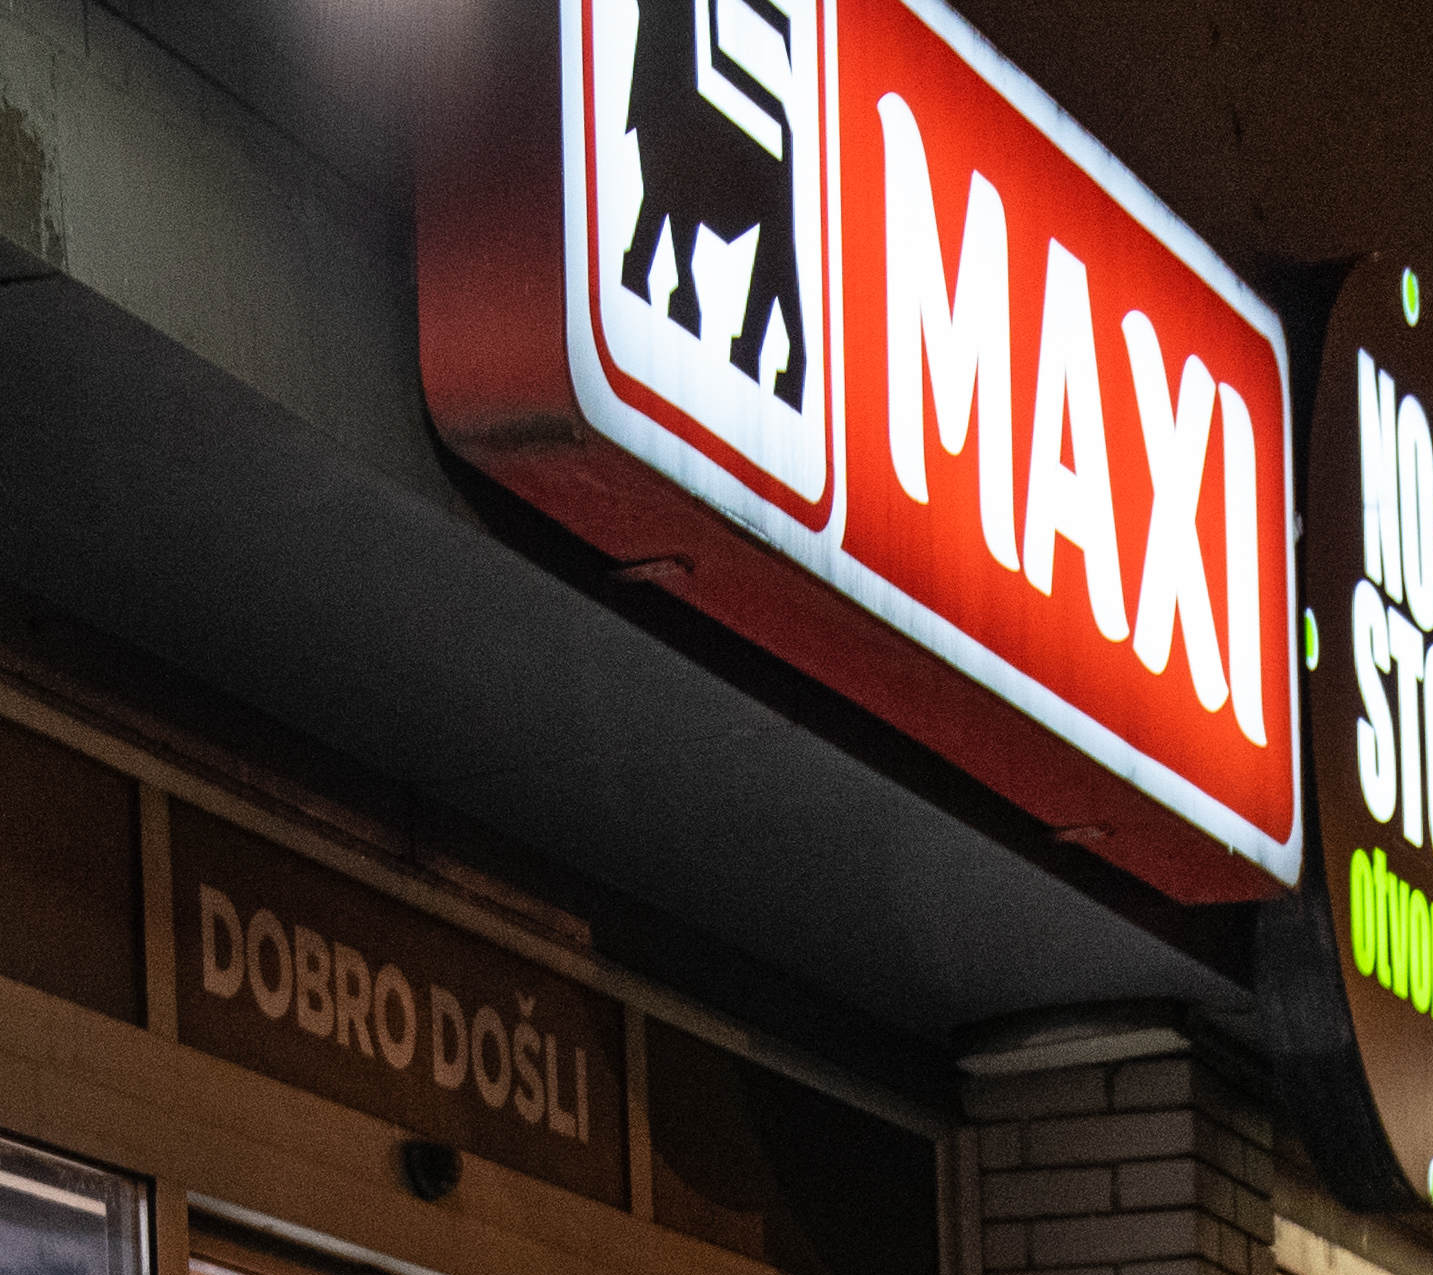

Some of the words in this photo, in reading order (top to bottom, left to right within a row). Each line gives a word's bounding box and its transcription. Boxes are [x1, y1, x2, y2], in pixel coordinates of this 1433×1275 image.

[876, 92, 1268, 750] MAXI
[199, 882, 418, 1070] DOBRO
[430, 983, 590, 1144] DOŠLI
